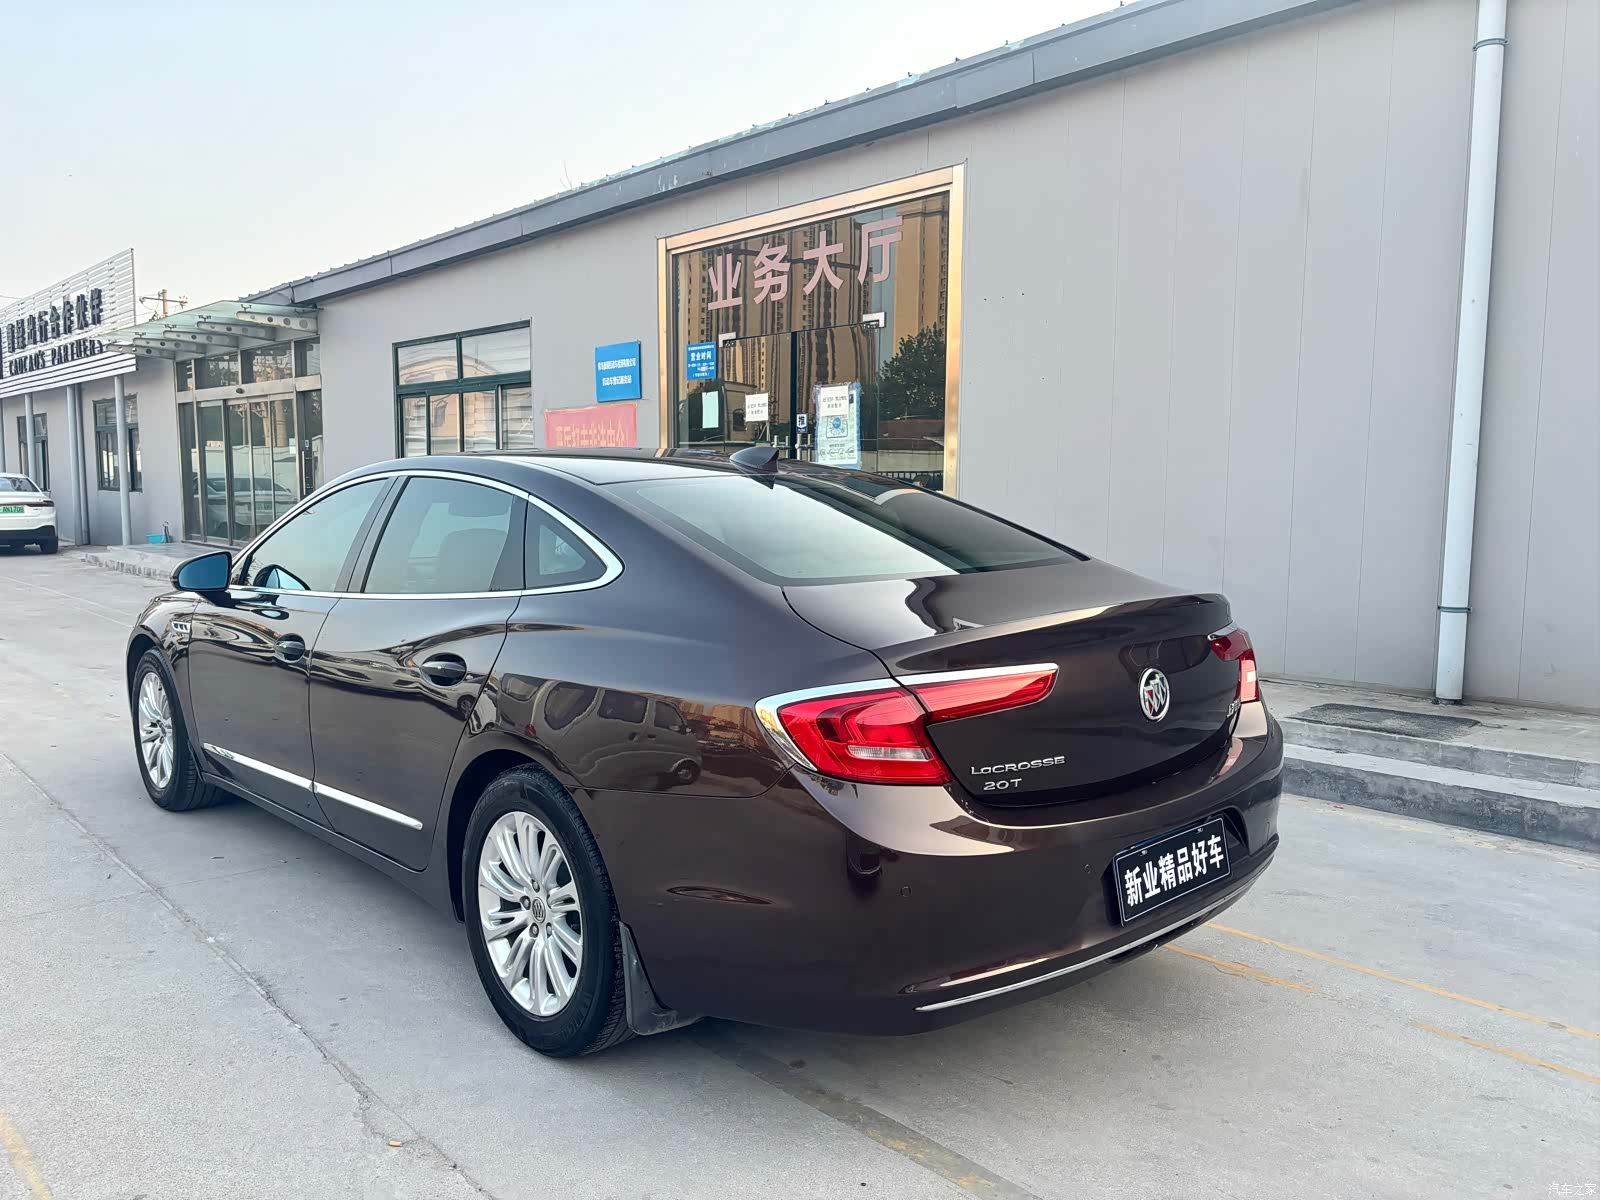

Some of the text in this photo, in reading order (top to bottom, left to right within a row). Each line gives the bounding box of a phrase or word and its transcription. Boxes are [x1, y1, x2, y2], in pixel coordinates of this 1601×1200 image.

[708, 215, 903, 311] 业务大厅
[691, 351, 711, 361] 营业时间
[798, 415, 806, 426] 推
[983, 778, 1023, 791] 20T
[1124, 834, 1224, 907] 新业精品好车
